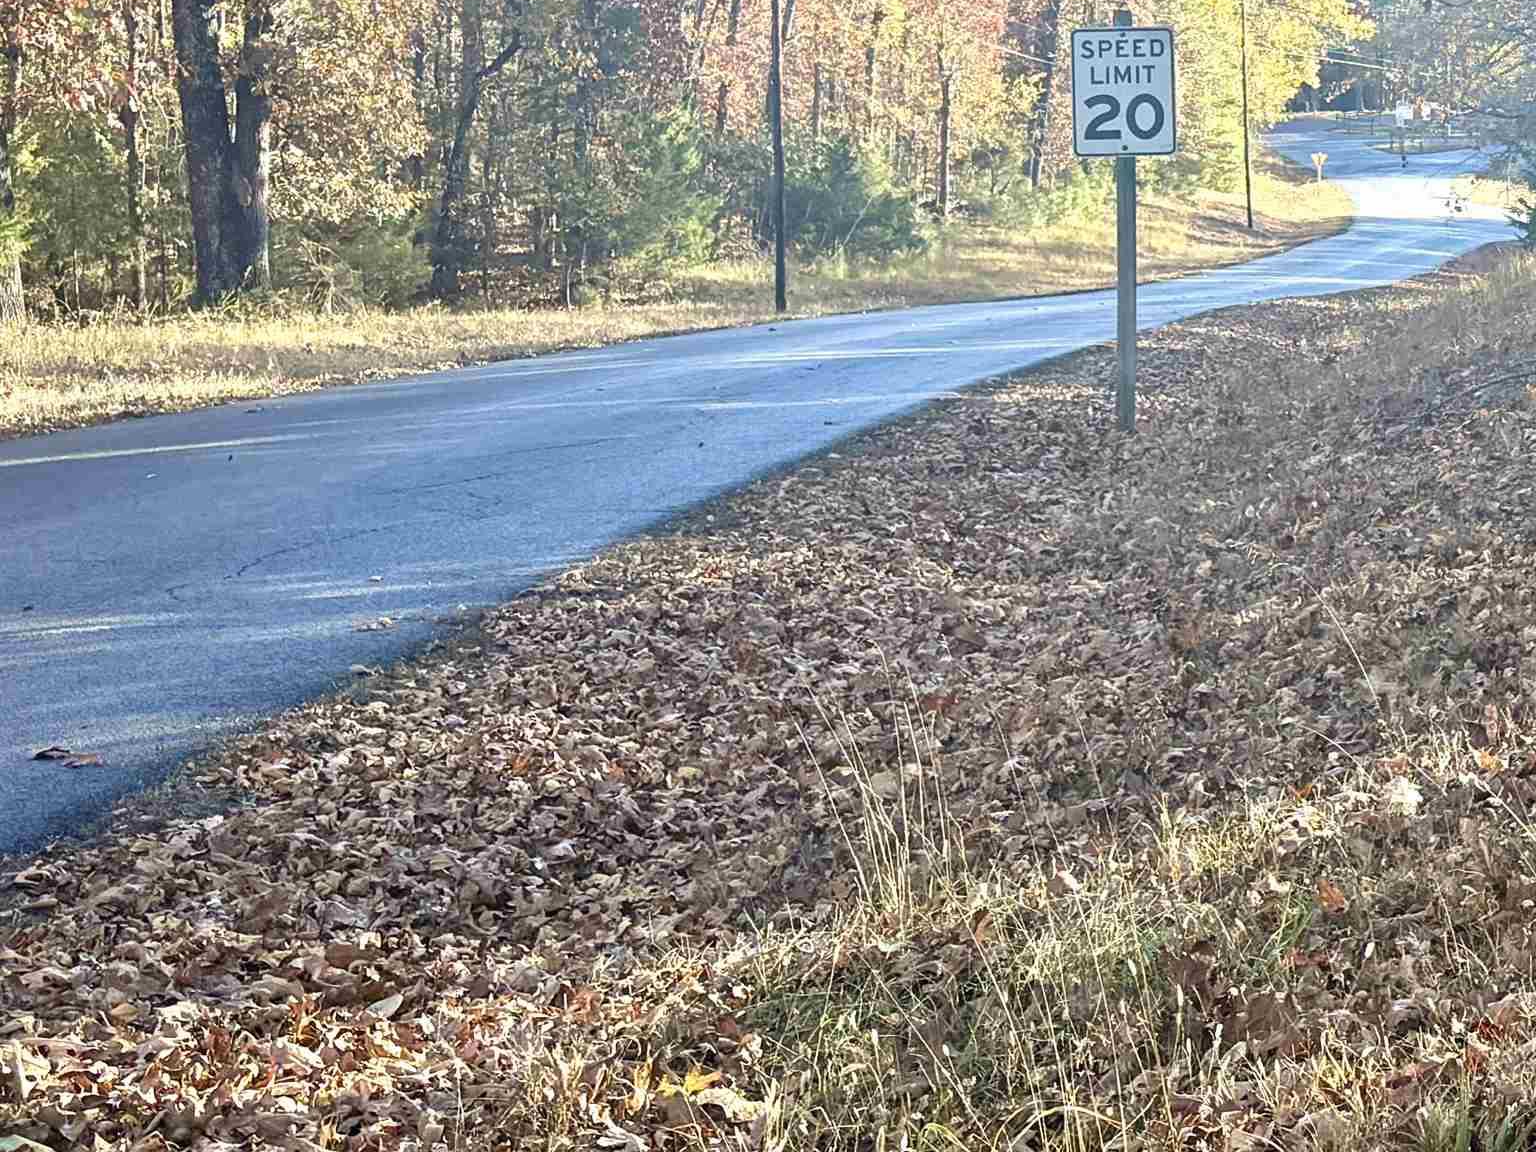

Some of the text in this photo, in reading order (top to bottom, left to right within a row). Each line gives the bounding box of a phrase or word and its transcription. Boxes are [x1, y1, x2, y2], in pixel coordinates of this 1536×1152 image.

[1080, 39, 1165, 59] SPEED
[1090, 65, 1156, 84] LIMIT
[1083, 93, 1165, 140] 20
